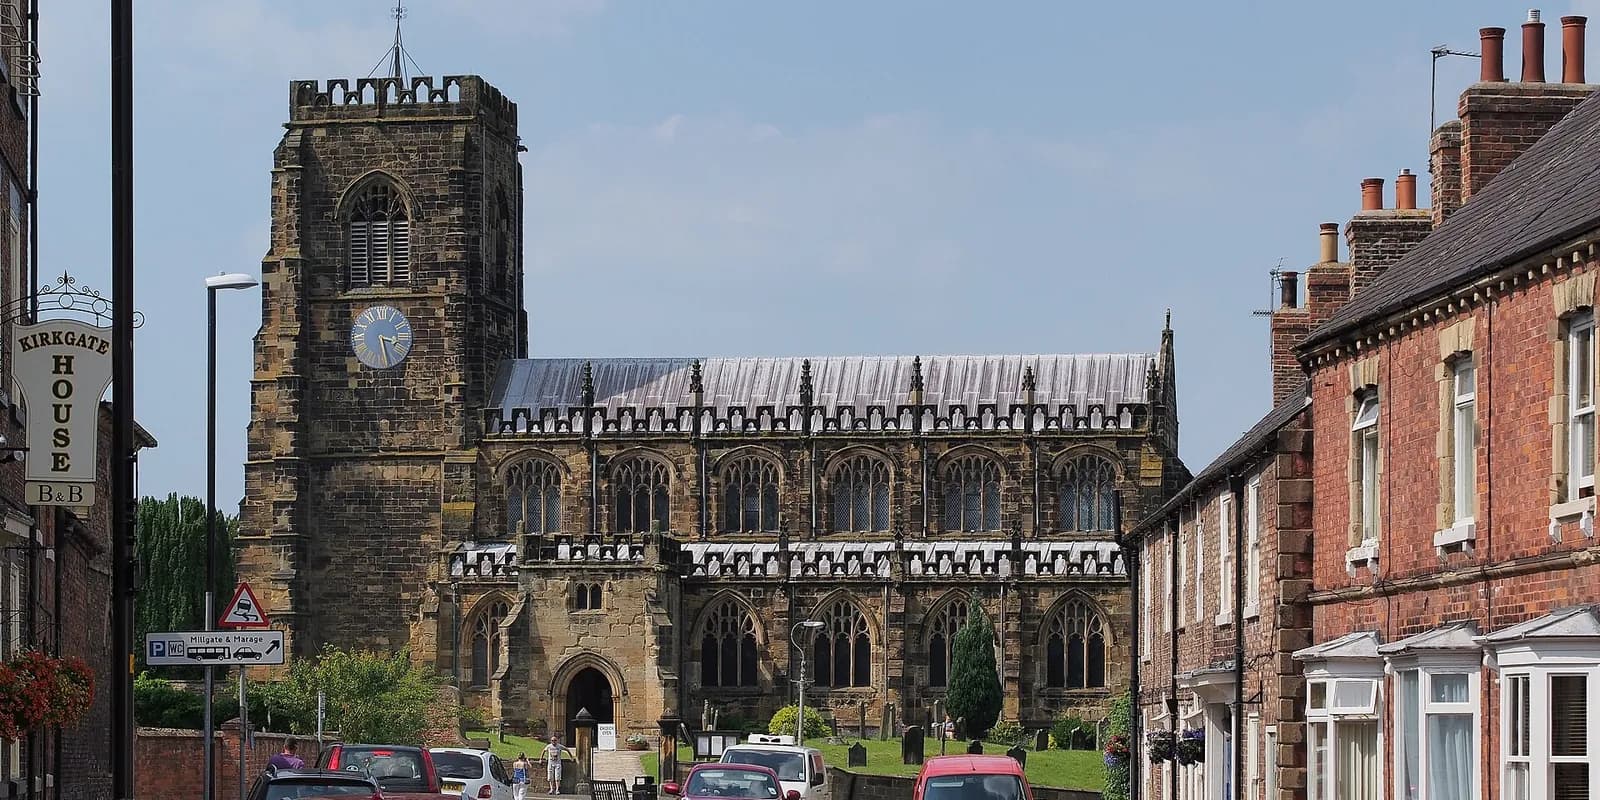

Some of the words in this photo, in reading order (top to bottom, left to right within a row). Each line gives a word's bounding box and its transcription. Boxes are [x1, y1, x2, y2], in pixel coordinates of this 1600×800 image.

[18, 331, 110, 355] KIRKGATE
[51, 354, 74, 472] HOUSE
[190, 636, 223, 644] Millgate
[153, 643, 164, 657] P
[169, 643, 184, 654] WC
